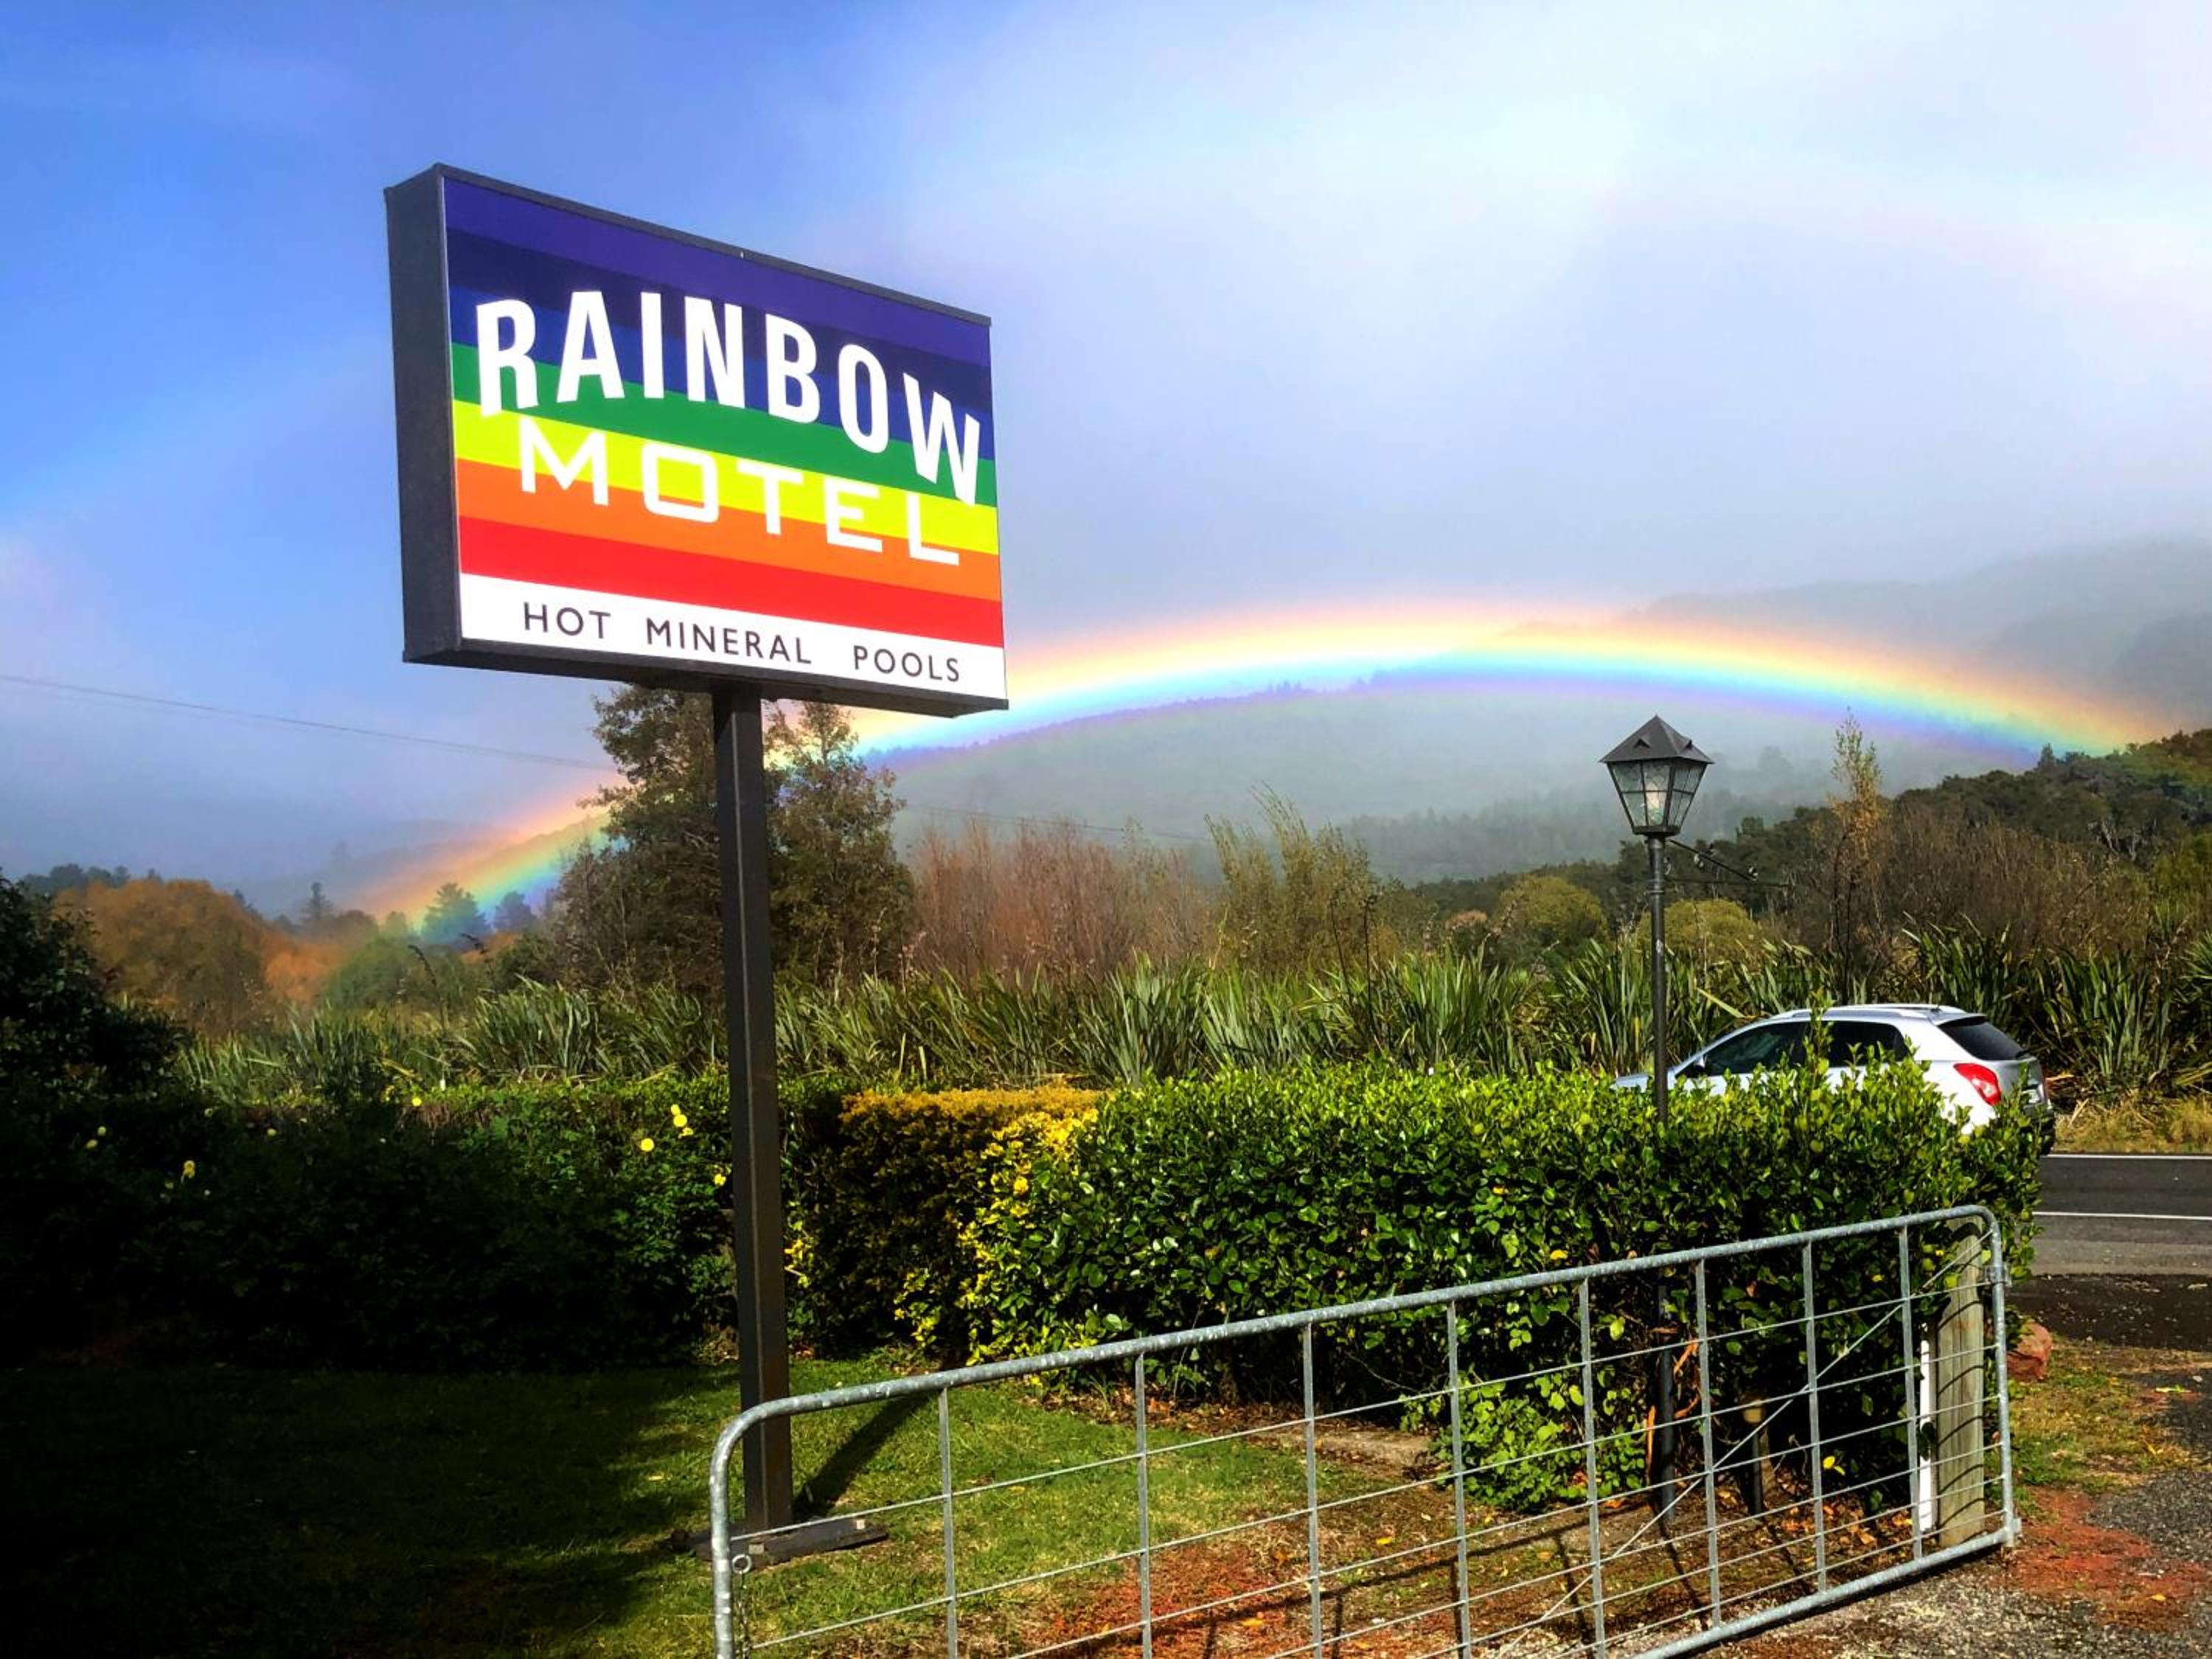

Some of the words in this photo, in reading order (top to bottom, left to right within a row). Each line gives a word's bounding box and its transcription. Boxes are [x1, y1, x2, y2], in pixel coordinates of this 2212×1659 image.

[476, 291, 980, 507] RAINBOW
[518, 417, 960, 566] MOTEL
[524, 602, 611, 640] HOT
[646, 617, 813, 665] MINERAL
[853, 644, 961, 683] POOLS
